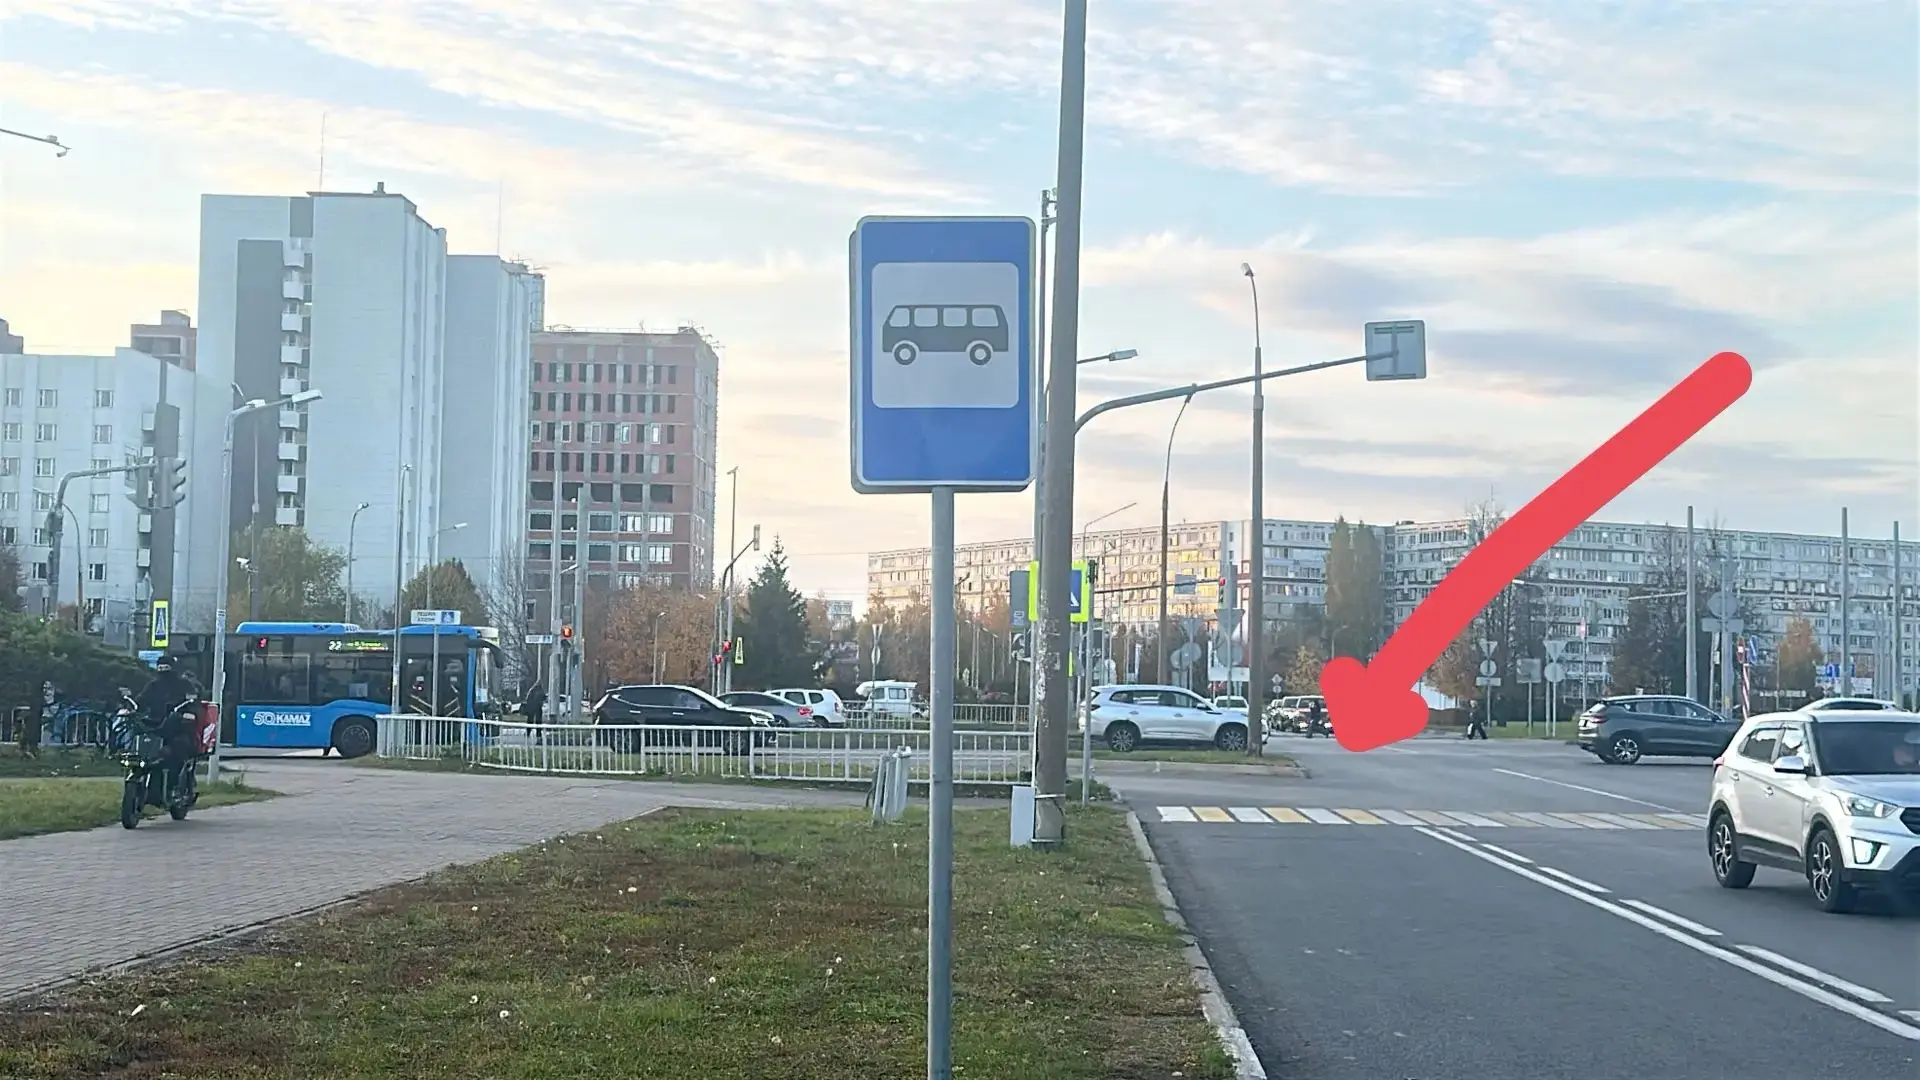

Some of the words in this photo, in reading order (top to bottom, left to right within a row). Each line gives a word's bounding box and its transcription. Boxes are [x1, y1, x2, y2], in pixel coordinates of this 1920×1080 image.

[329, 641, 342, 650] 22
[253, 712, 275, 725] 50
[276, 714, 311, 724] KAMAZ
